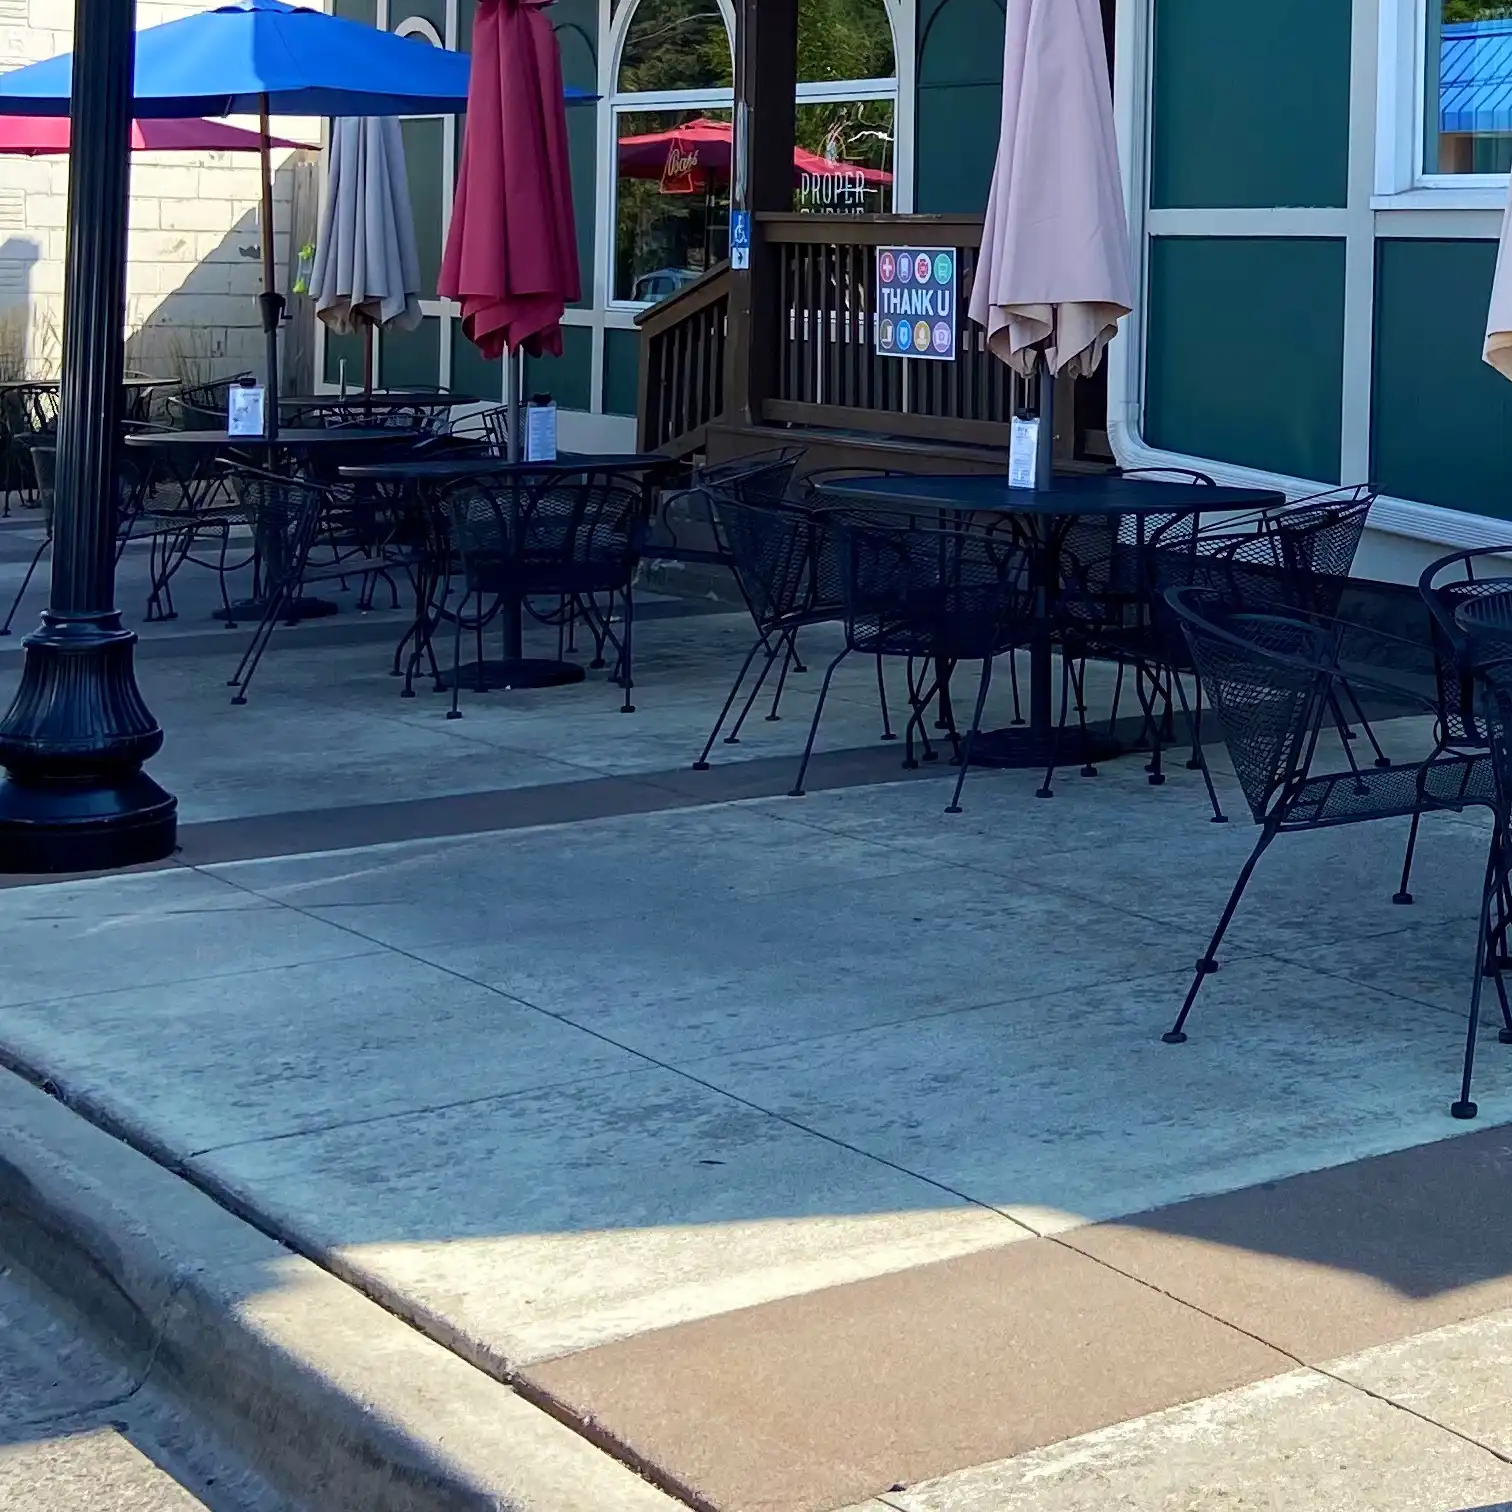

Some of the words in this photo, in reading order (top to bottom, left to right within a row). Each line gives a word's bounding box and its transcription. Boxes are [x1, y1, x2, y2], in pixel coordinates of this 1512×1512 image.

[801, 170, 865, 205] PROPER
[881, 287, 934, 316] THANK
[937, 289, 950, 317] U
